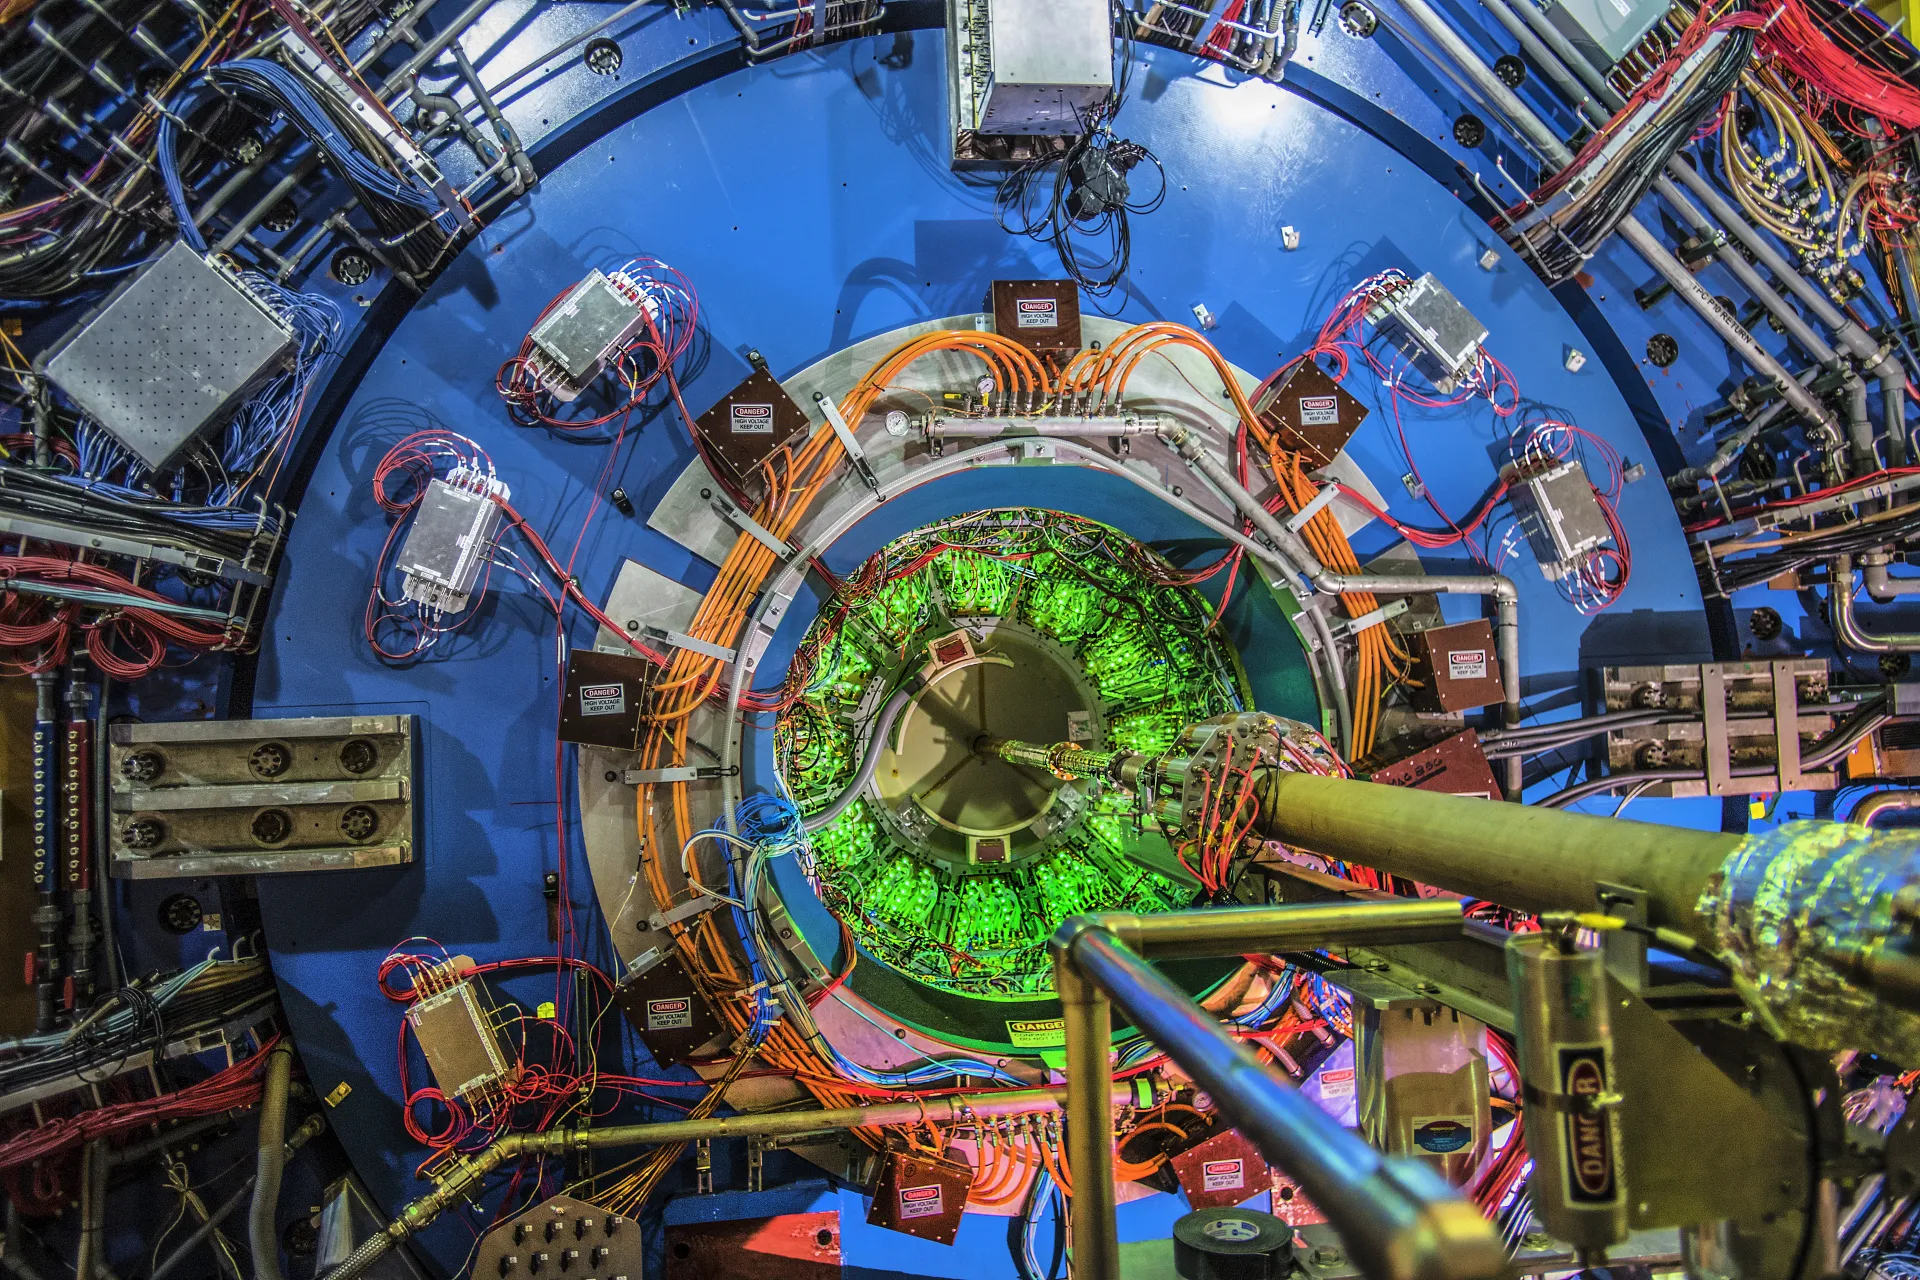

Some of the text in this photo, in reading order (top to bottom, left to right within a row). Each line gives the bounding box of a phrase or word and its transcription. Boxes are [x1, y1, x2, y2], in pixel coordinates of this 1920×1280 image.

[332, 80, 350, 97] 22
[1692, 282, 1709, 300] TPC
[1720, 311, 1752, 344] RETURN
[1869, 485, 1883, 499] 14
[656, 1003, 682, 1011] DANGER
[1211, 1164, 1235, 1172] DANGER
[907, 1190, 934, 1199] DANGER
